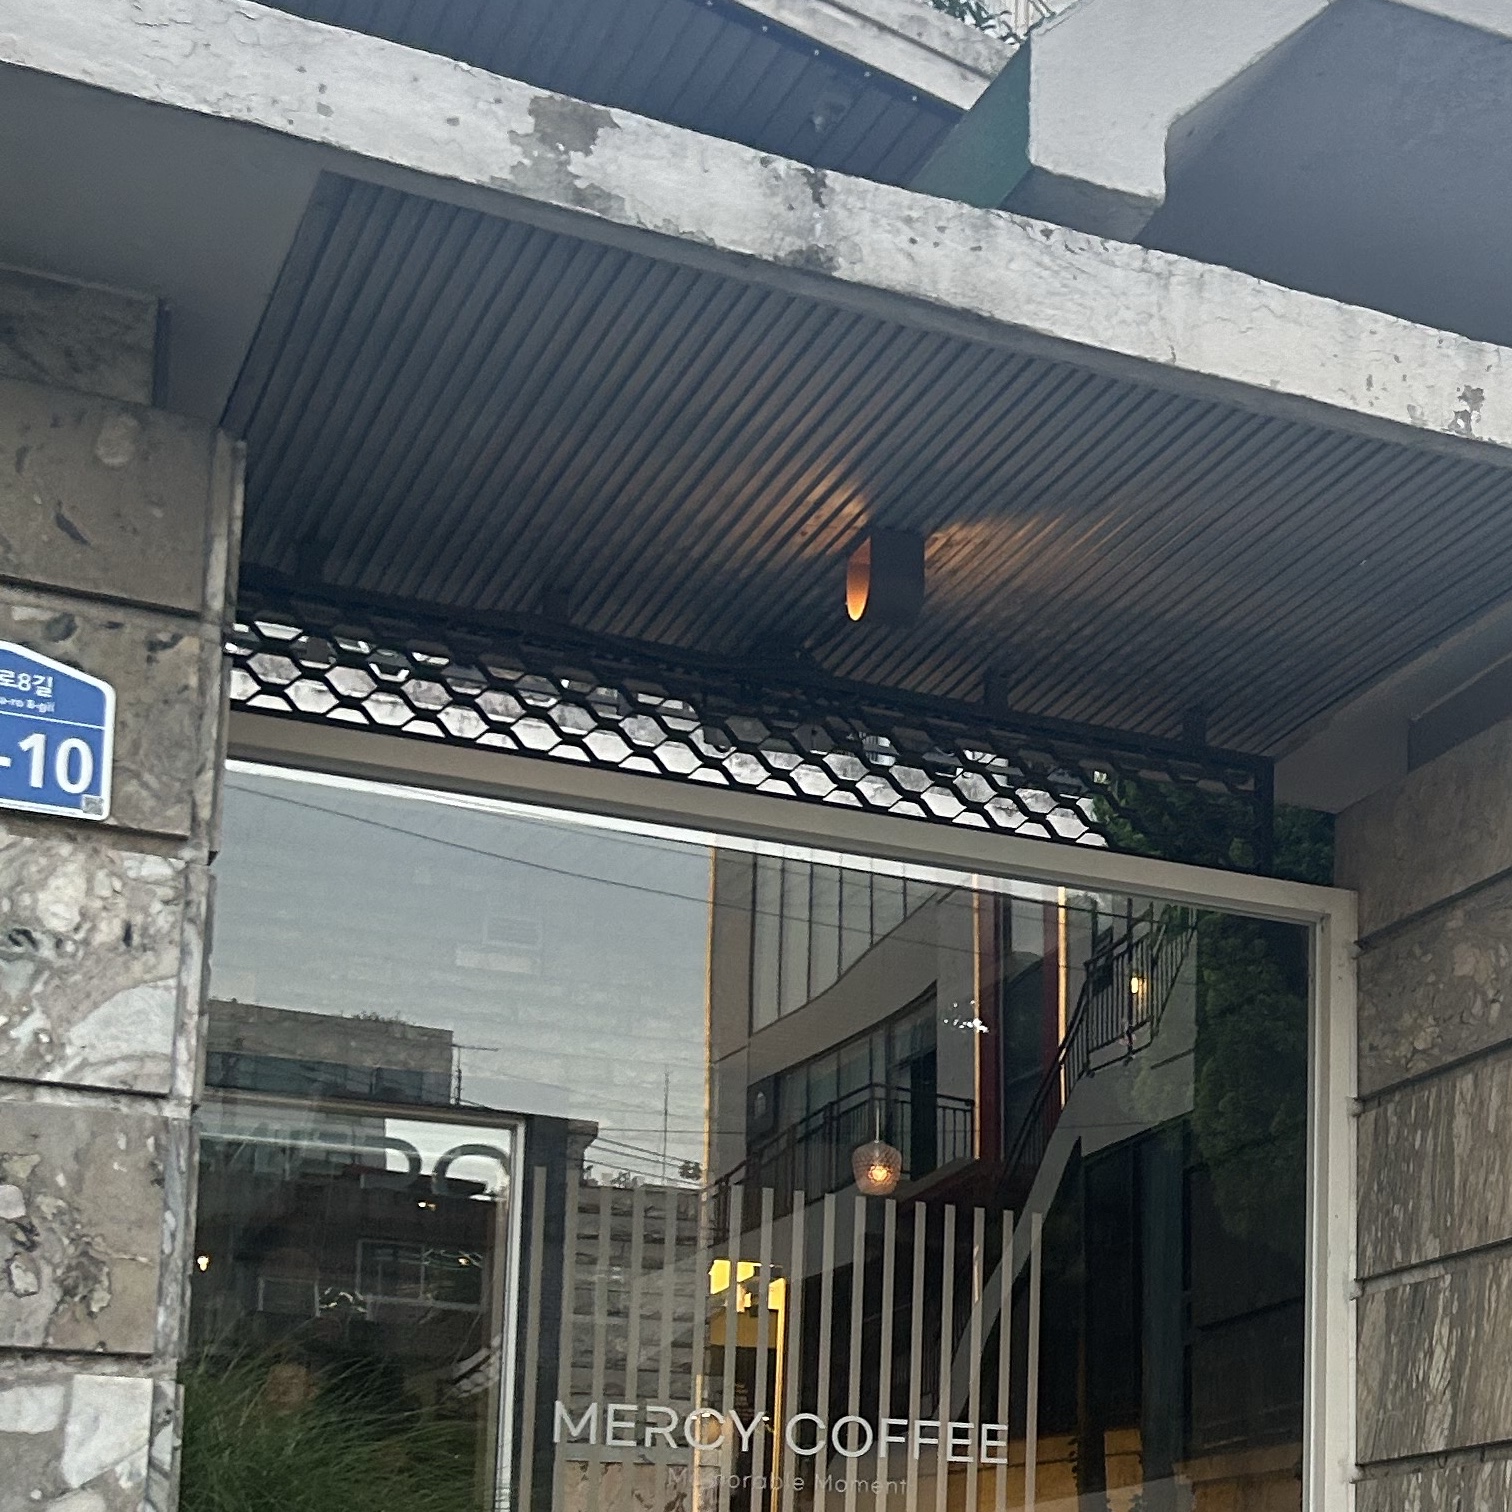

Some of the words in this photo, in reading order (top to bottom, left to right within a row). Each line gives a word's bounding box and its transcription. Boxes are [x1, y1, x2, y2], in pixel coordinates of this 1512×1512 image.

[552, 1399, 766, 1452] MERCY
[785, 1412, 1008, 1464] COFFEE
[668, 1466, 804, 1491] Morabe
[814, 1474, 907, 1495] Moment
